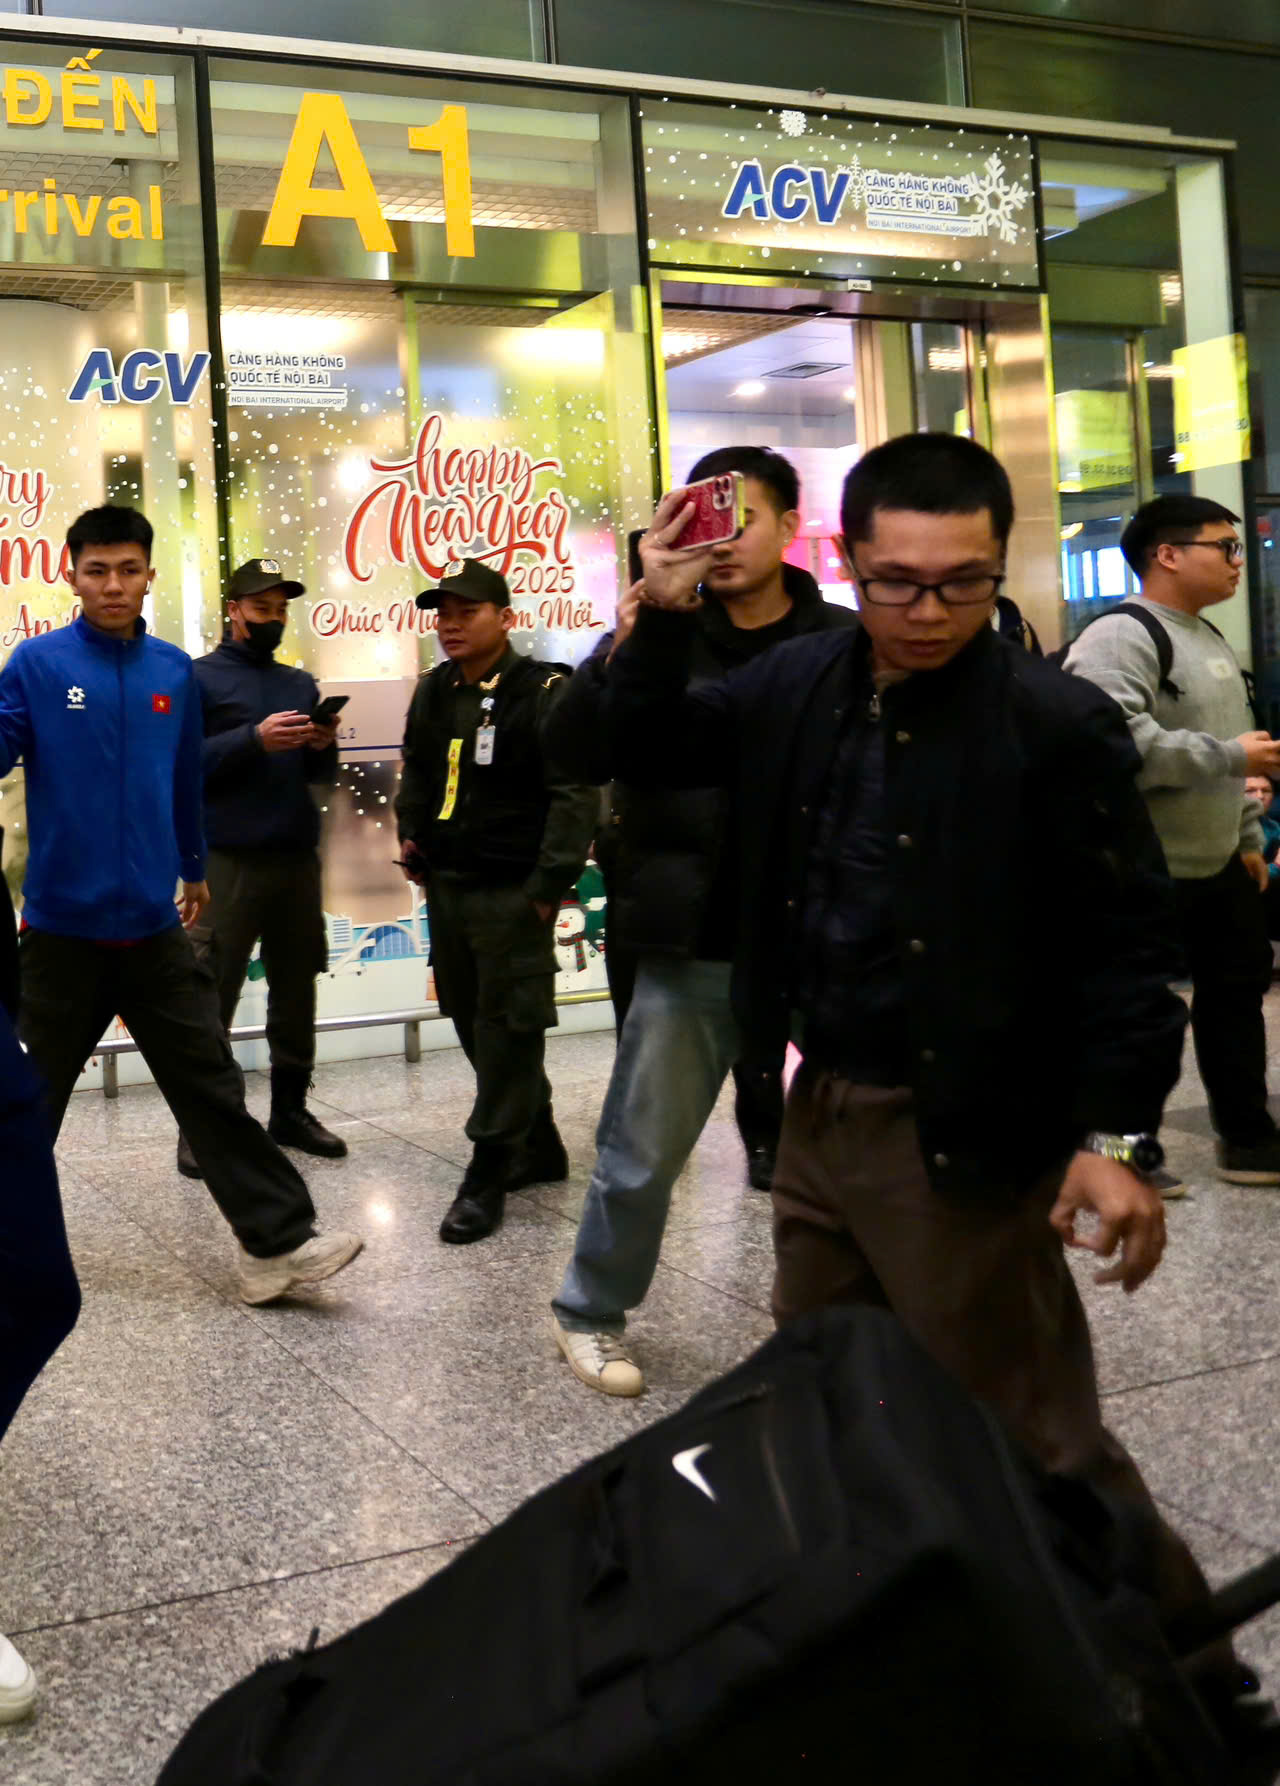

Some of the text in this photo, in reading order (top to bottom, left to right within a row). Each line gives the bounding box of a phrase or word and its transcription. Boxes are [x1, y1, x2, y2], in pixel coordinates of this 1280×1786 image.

[2, 47, 159, 135] ĐẾN
[723, 164, 850, 223] ACV
[932, 179, 969, 195] KHÔNG
[894, 221, 944, 232] INTERNATIONAL
[266, 353, 299, 367] HÀNG
[303, 355, 344, 368] KHÔNG
[68, 351, 210, 403] ACV
[230, 368, 329, 388] QUỐC TẾ NỘI BÀI
[260, 397, 315, 405] INTERNATIONAL
[345, 480, 570, 582] New Year
[511, 565, 576, 594] 2025
[312, 601, 383, 637] Chúc
[539, 598, 606, 630] Mới
